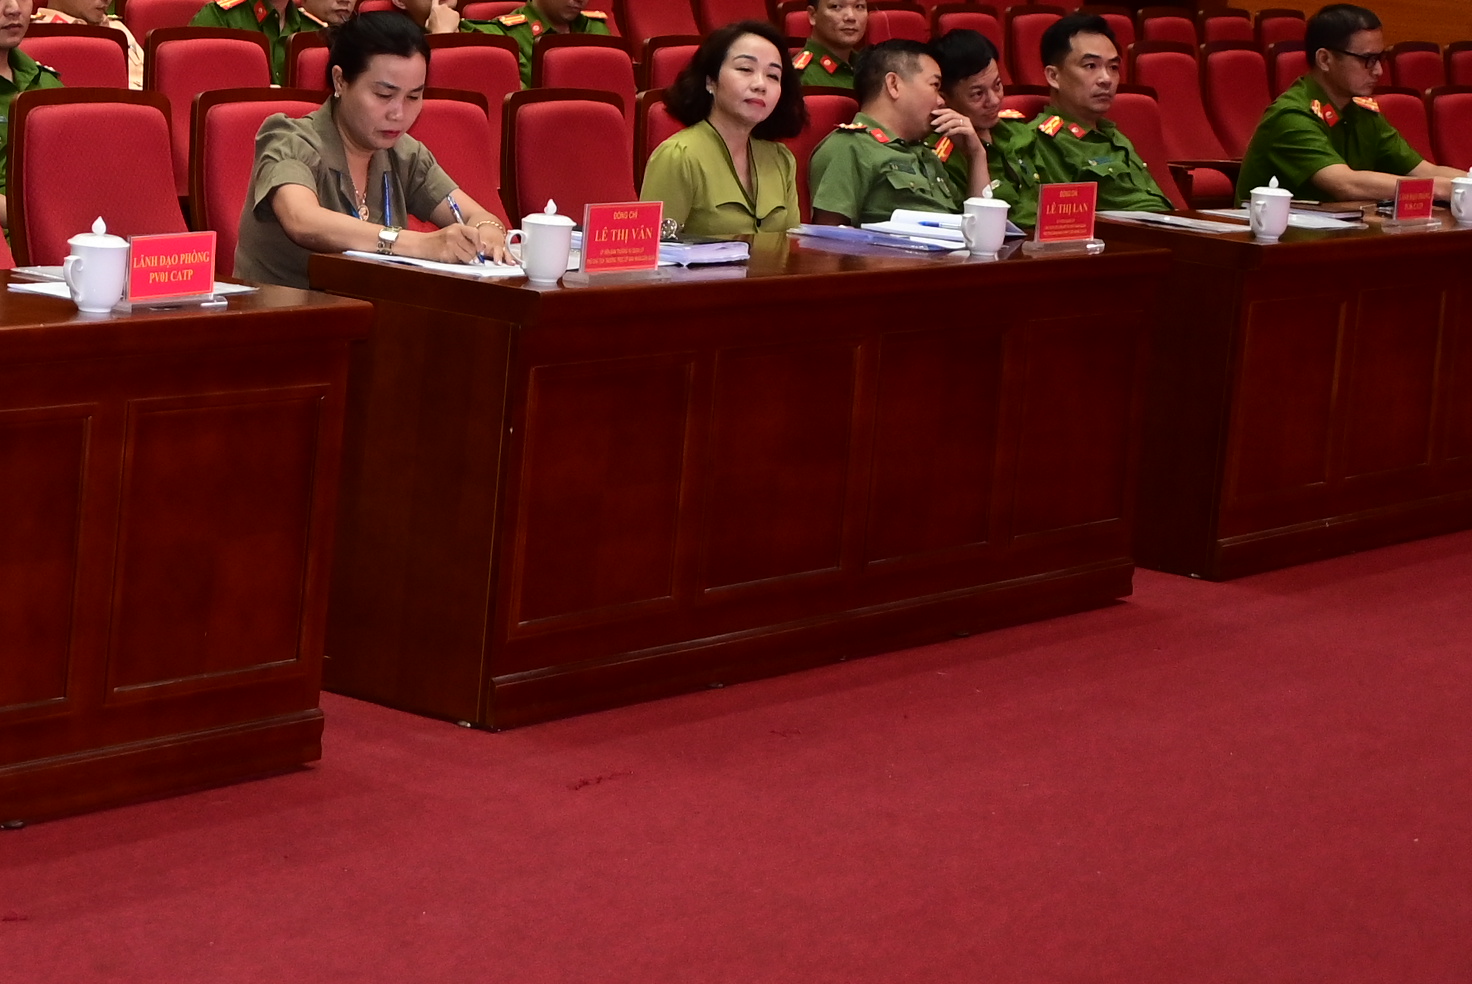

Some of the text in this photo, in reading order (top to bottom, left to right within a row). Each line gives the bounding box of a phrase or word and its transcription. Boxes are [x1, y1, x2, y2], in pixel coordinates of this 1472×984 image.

[1073, 202, 1088, 213] LAN
[595, 226, 608, 242] LÊ
[610, 228, 628, 244] THỊ
[133, 249, 210, 268] LÃNH ĐẠO PHÒNG
[149, 269, 194, 284] PV01 CATP
